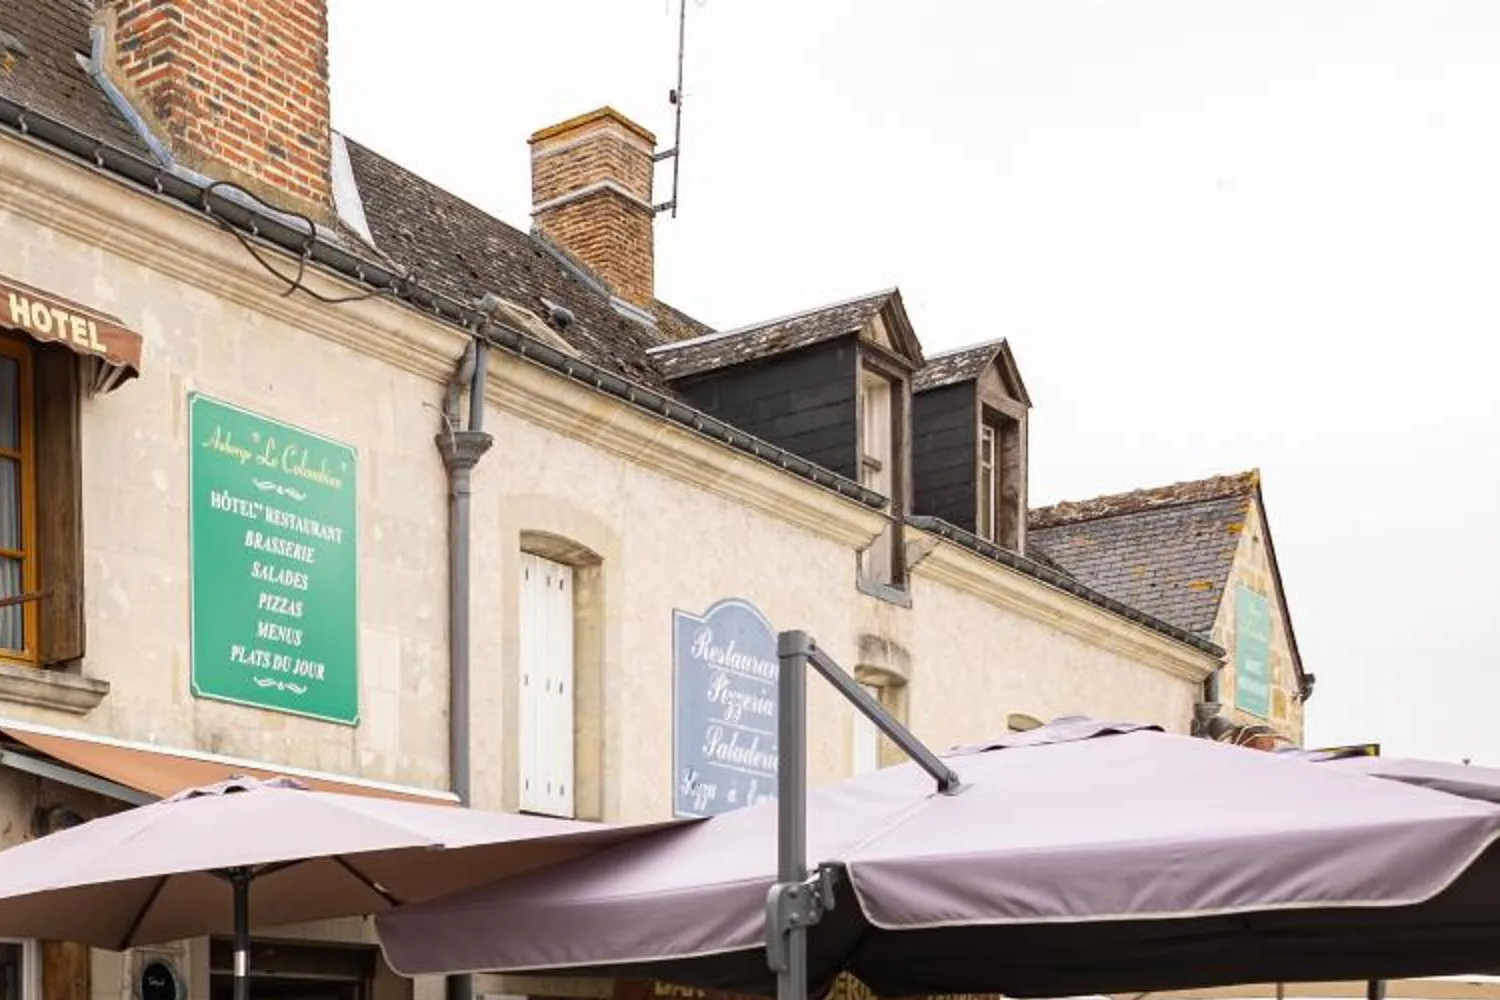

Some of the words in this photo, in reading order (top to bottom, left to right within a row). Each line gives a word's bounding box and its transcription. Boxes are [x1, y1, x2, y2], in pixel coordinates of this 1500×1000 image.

[8, 293, 107, 353] HOTEL
[266, 506, 343, 544] RESTAURANT
[245, 530, 315, 563] BRASSERIE
[252, 561, 308, 590] SALADES
[258, 592, 303, 618] PIZZAS
[257, 621, 303, 647] MENUS
[230, 645, 271, 669] PLATS
[273, 653, 291, 673] DU
[293, 658, 325, 680] JOUR
[691, 628, 779, 678] Restauran
[708, 672, 773, 721] Pizzeria
